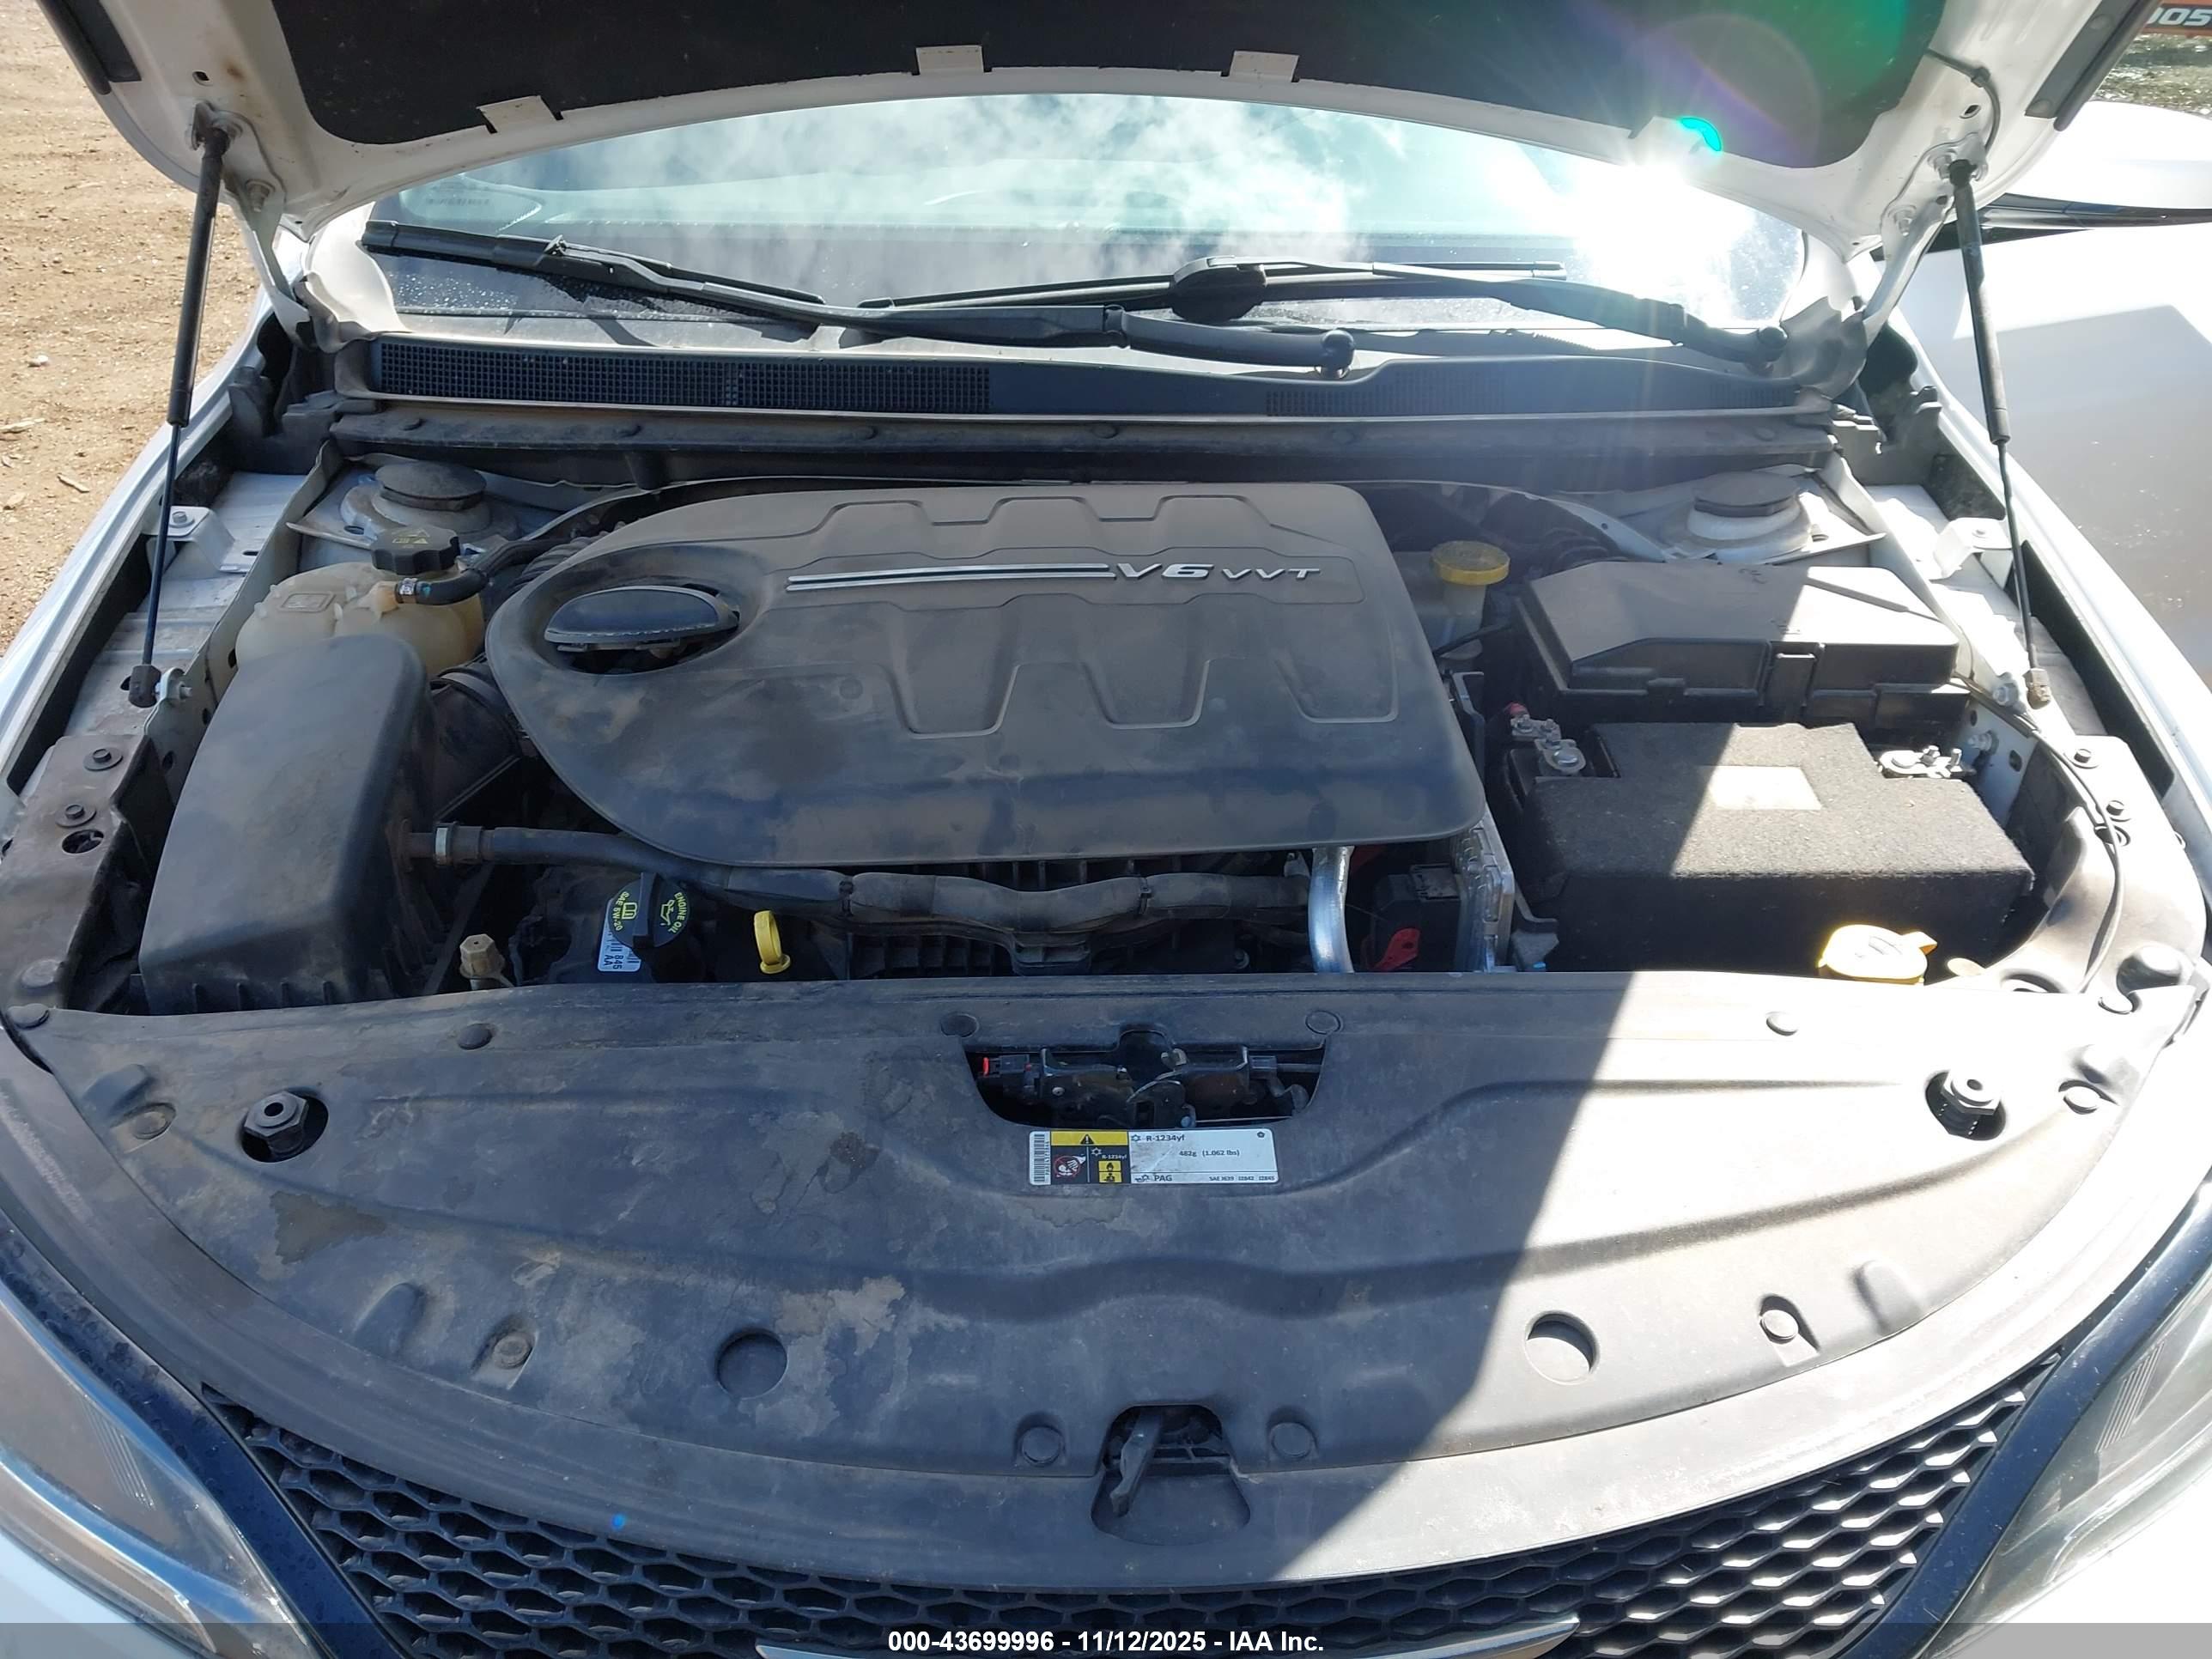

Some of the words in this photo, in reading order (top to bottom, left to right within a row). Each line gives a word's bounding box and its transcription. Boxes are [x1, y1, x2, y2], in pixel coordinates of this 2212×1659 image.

[1117, 563, 1214, 578] V6
[1222, 568, 1321, 579] VVT
[616, 891, 629, 906] SAE
[674, 892, 687, 921] ENGINE
[611, 908, 623, 931] 5W-20
[668, 922, 682, 933] OIL
